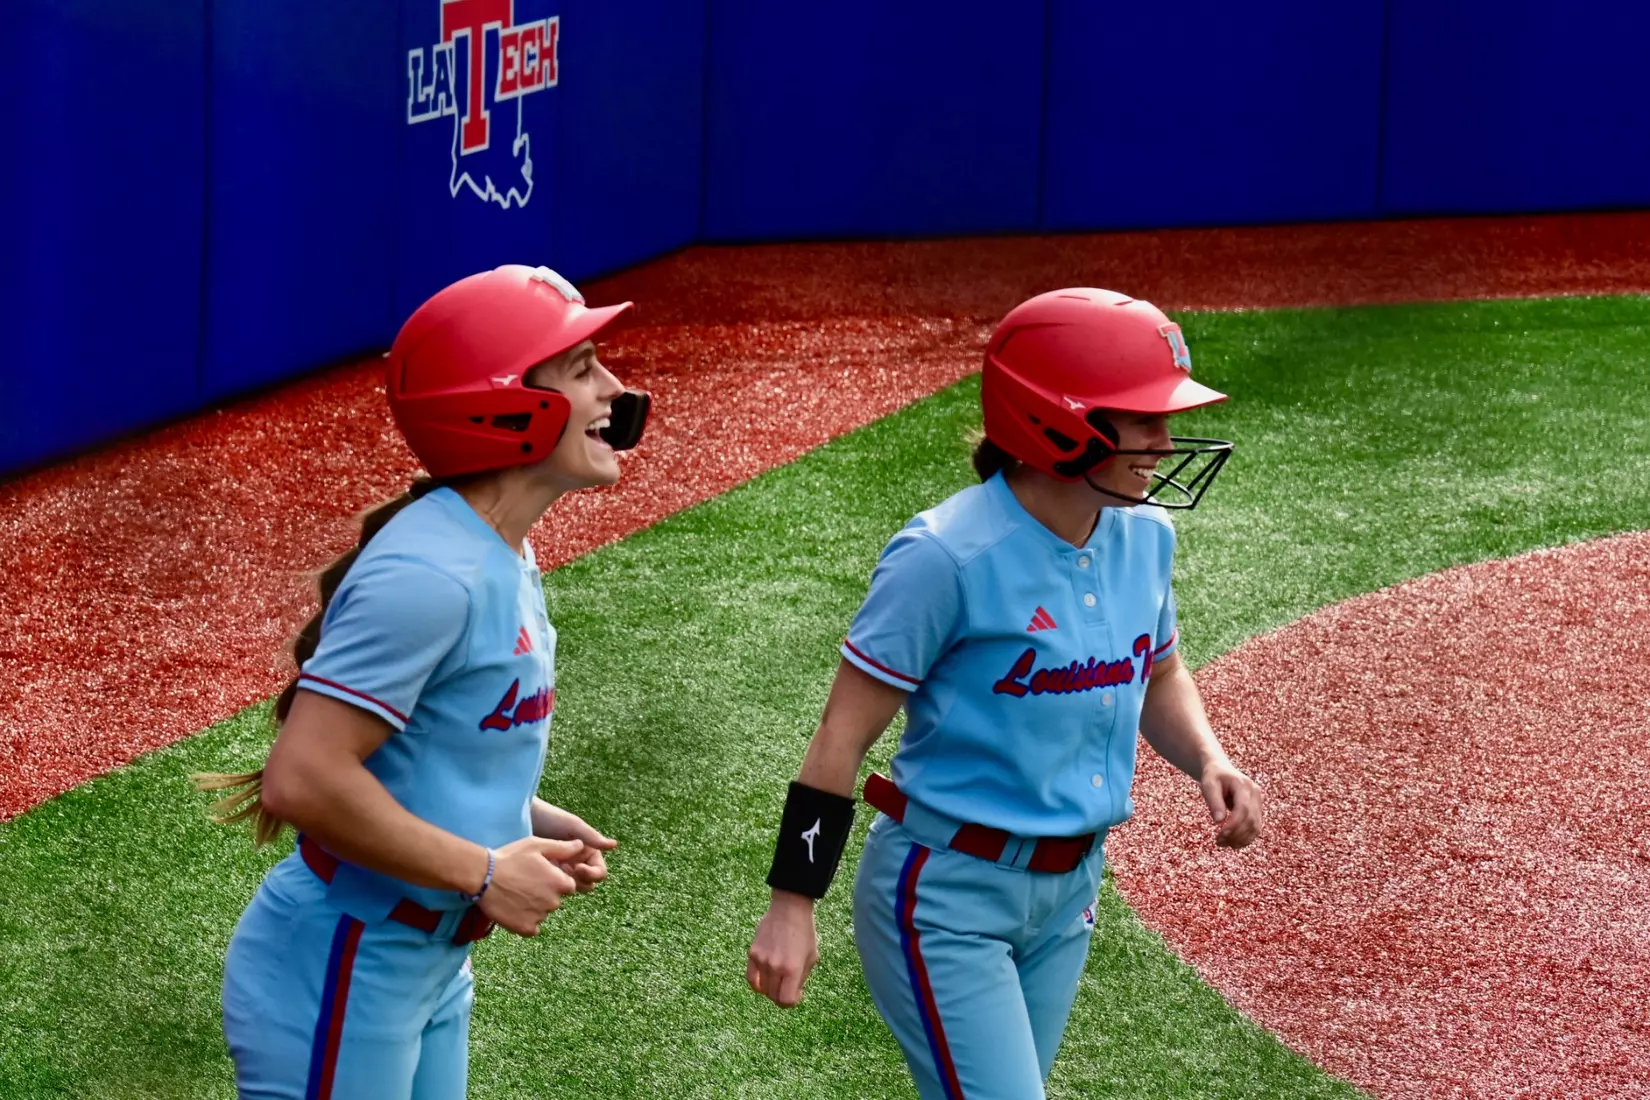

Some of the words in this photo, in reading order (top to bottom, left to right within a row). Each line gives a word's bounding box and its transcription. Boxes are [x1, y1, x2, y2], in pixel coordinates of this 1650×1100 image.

[407, 44, 458, 124] LA
[440, 0, 559, 157] TECH
[993, 647, 1135, 698] Louisiana
[1132, 632, 1153, 684] T
